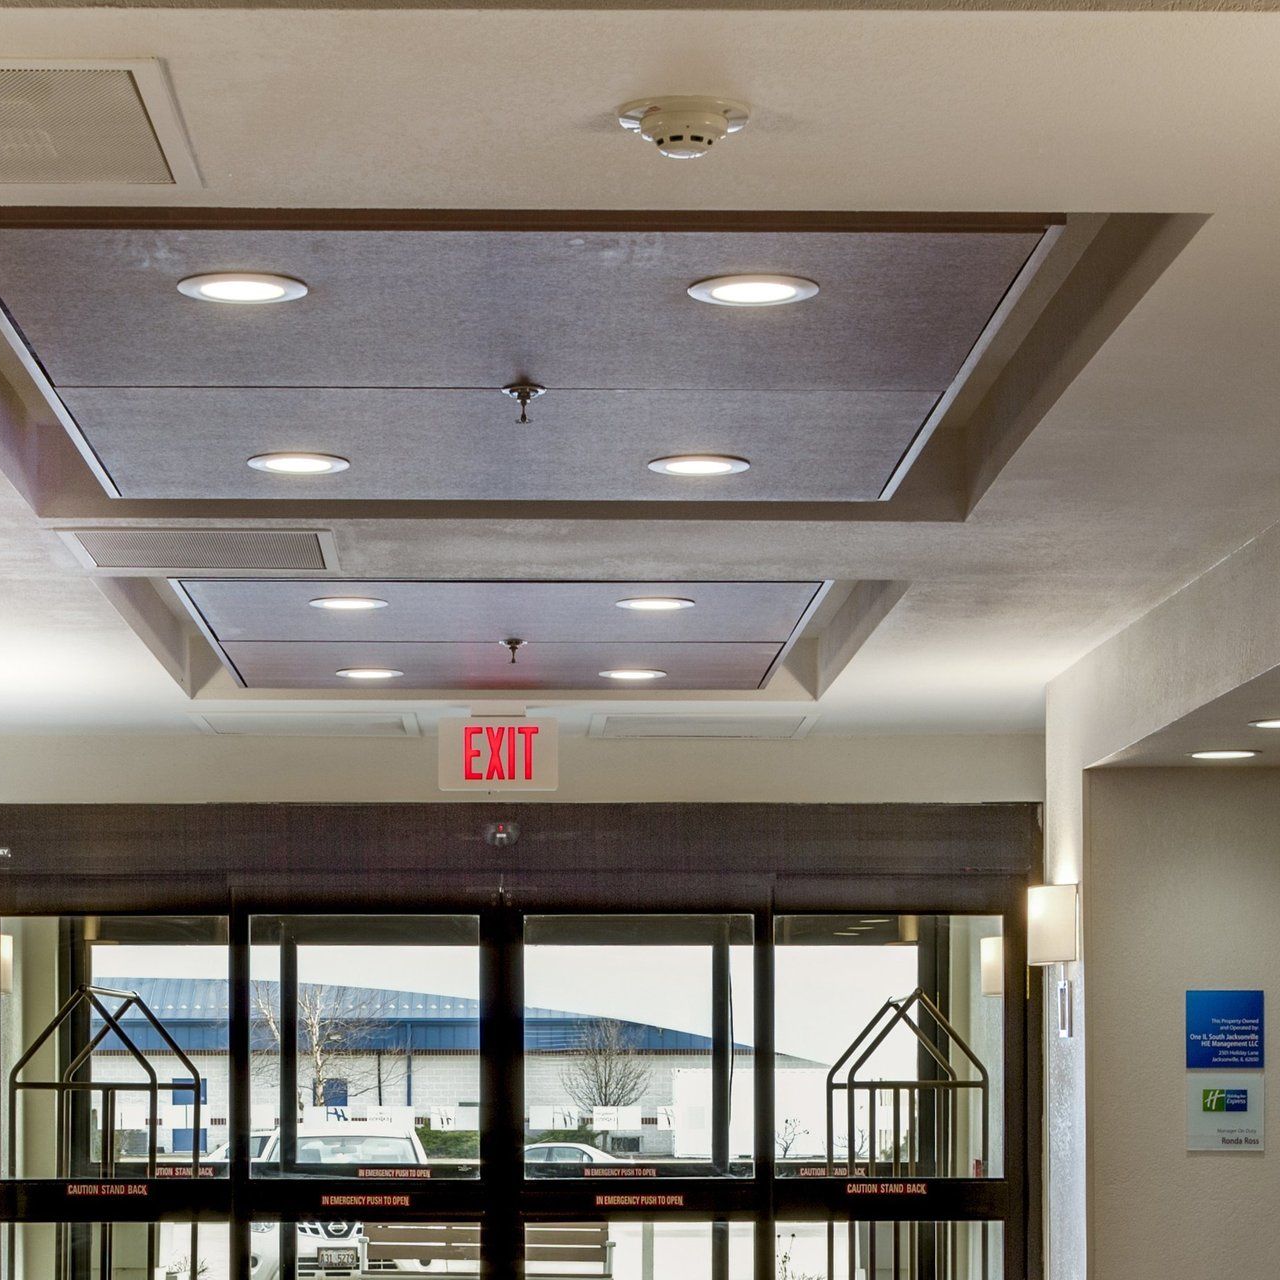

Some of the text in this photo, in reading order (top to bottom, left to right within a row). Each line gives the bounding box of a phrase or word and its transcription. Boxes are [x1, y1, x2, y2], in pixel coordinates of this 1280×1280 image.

[464, 726, 539, 780] EXIT
[155, 1167, 173, 1176] UTION
[358, 1169, 431, 1177] IN EMERGENCY PUSH TO OPEN
[584, 1168, 656, 1176] IN EMERGENCY PUSH TO OPEN
[800, 1167, 826, 1176] CAUTION
[68, 1184, 147, 1195] CAUTION STAND BACK
[847, 1183, 927, 1194] CAUTION STAND BACK
[322, 1196, 409, 1205] IN EMERGENCY PUSH TO OPEN
[596, 1196, 683, 1205] IN EMERGENCY PUSH TO OPEN
